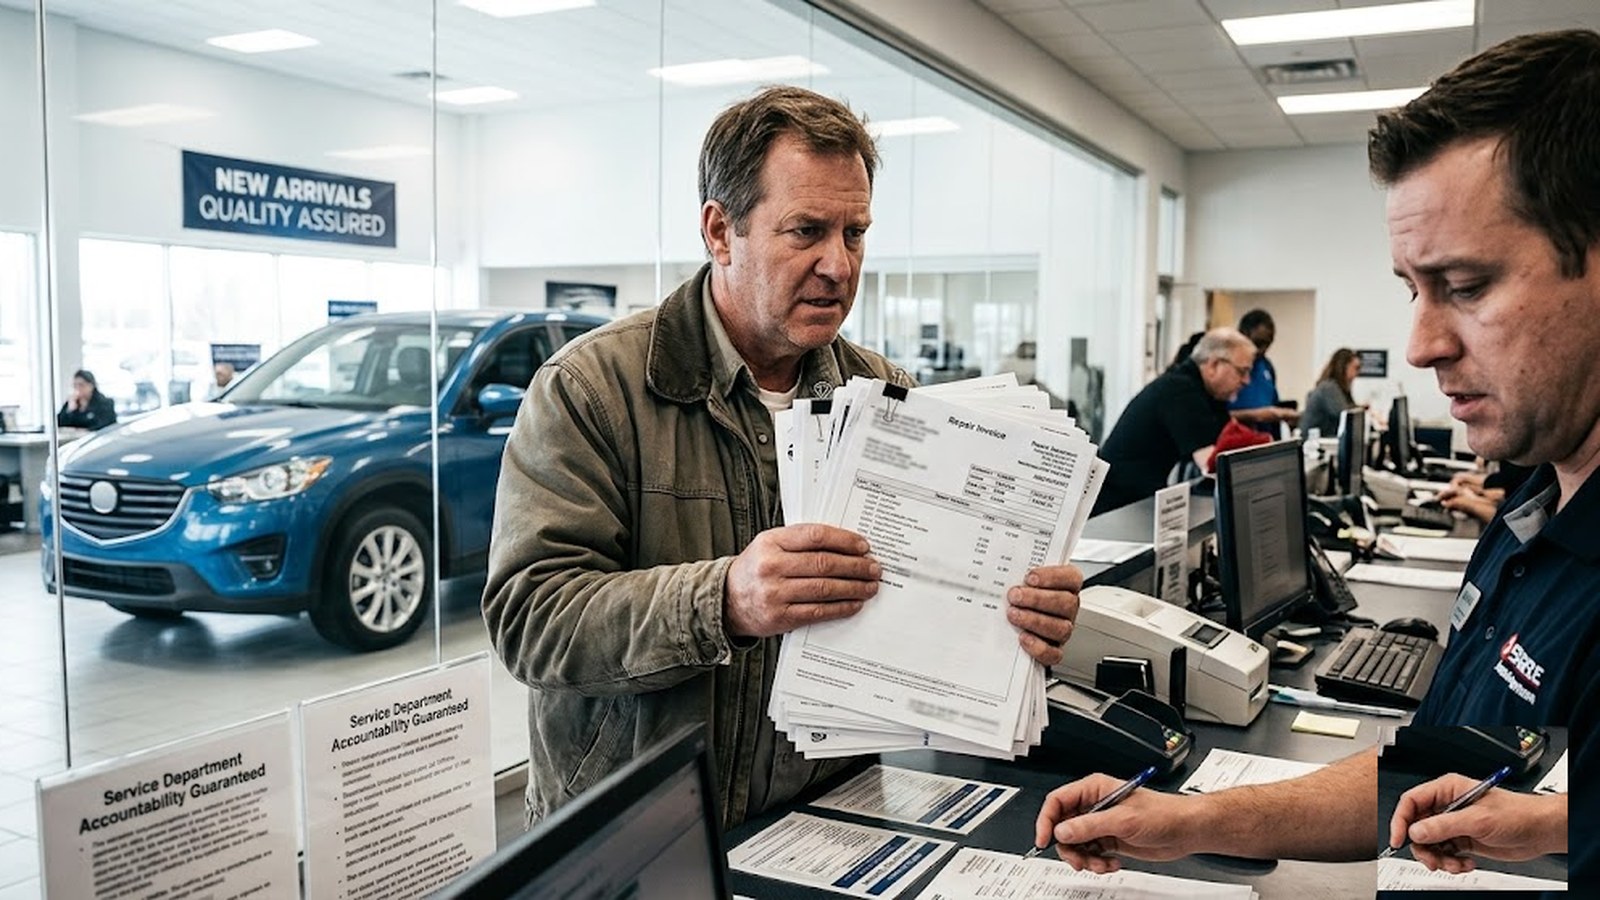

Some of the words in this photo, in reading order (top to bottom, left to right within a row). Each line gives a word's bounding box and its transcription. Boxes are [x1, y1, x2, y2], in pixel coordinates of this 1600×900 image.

[215, 167, 269, 197] NEW
[273, 176, 372, 209] ARRIVALS
[200, 194, 293, 227] QUALITY
[297, 207, 386, 237] ASSURED
[947, 416, 975, 431] Repair
[976, 425, 1006, 440] Invoice
[331, 720, 410, 752] Accountability
[412, 699, 469, 727] Guaranteed
[350, 709, 391, 728] Service
[393, 688, 453, 715] Department
[79, 790, 187, 834] Accountability
[190, 763, 266, 798] Guaranteed
[103, 779, 159, 806] Service
[163, 753, 243, 786] Department
